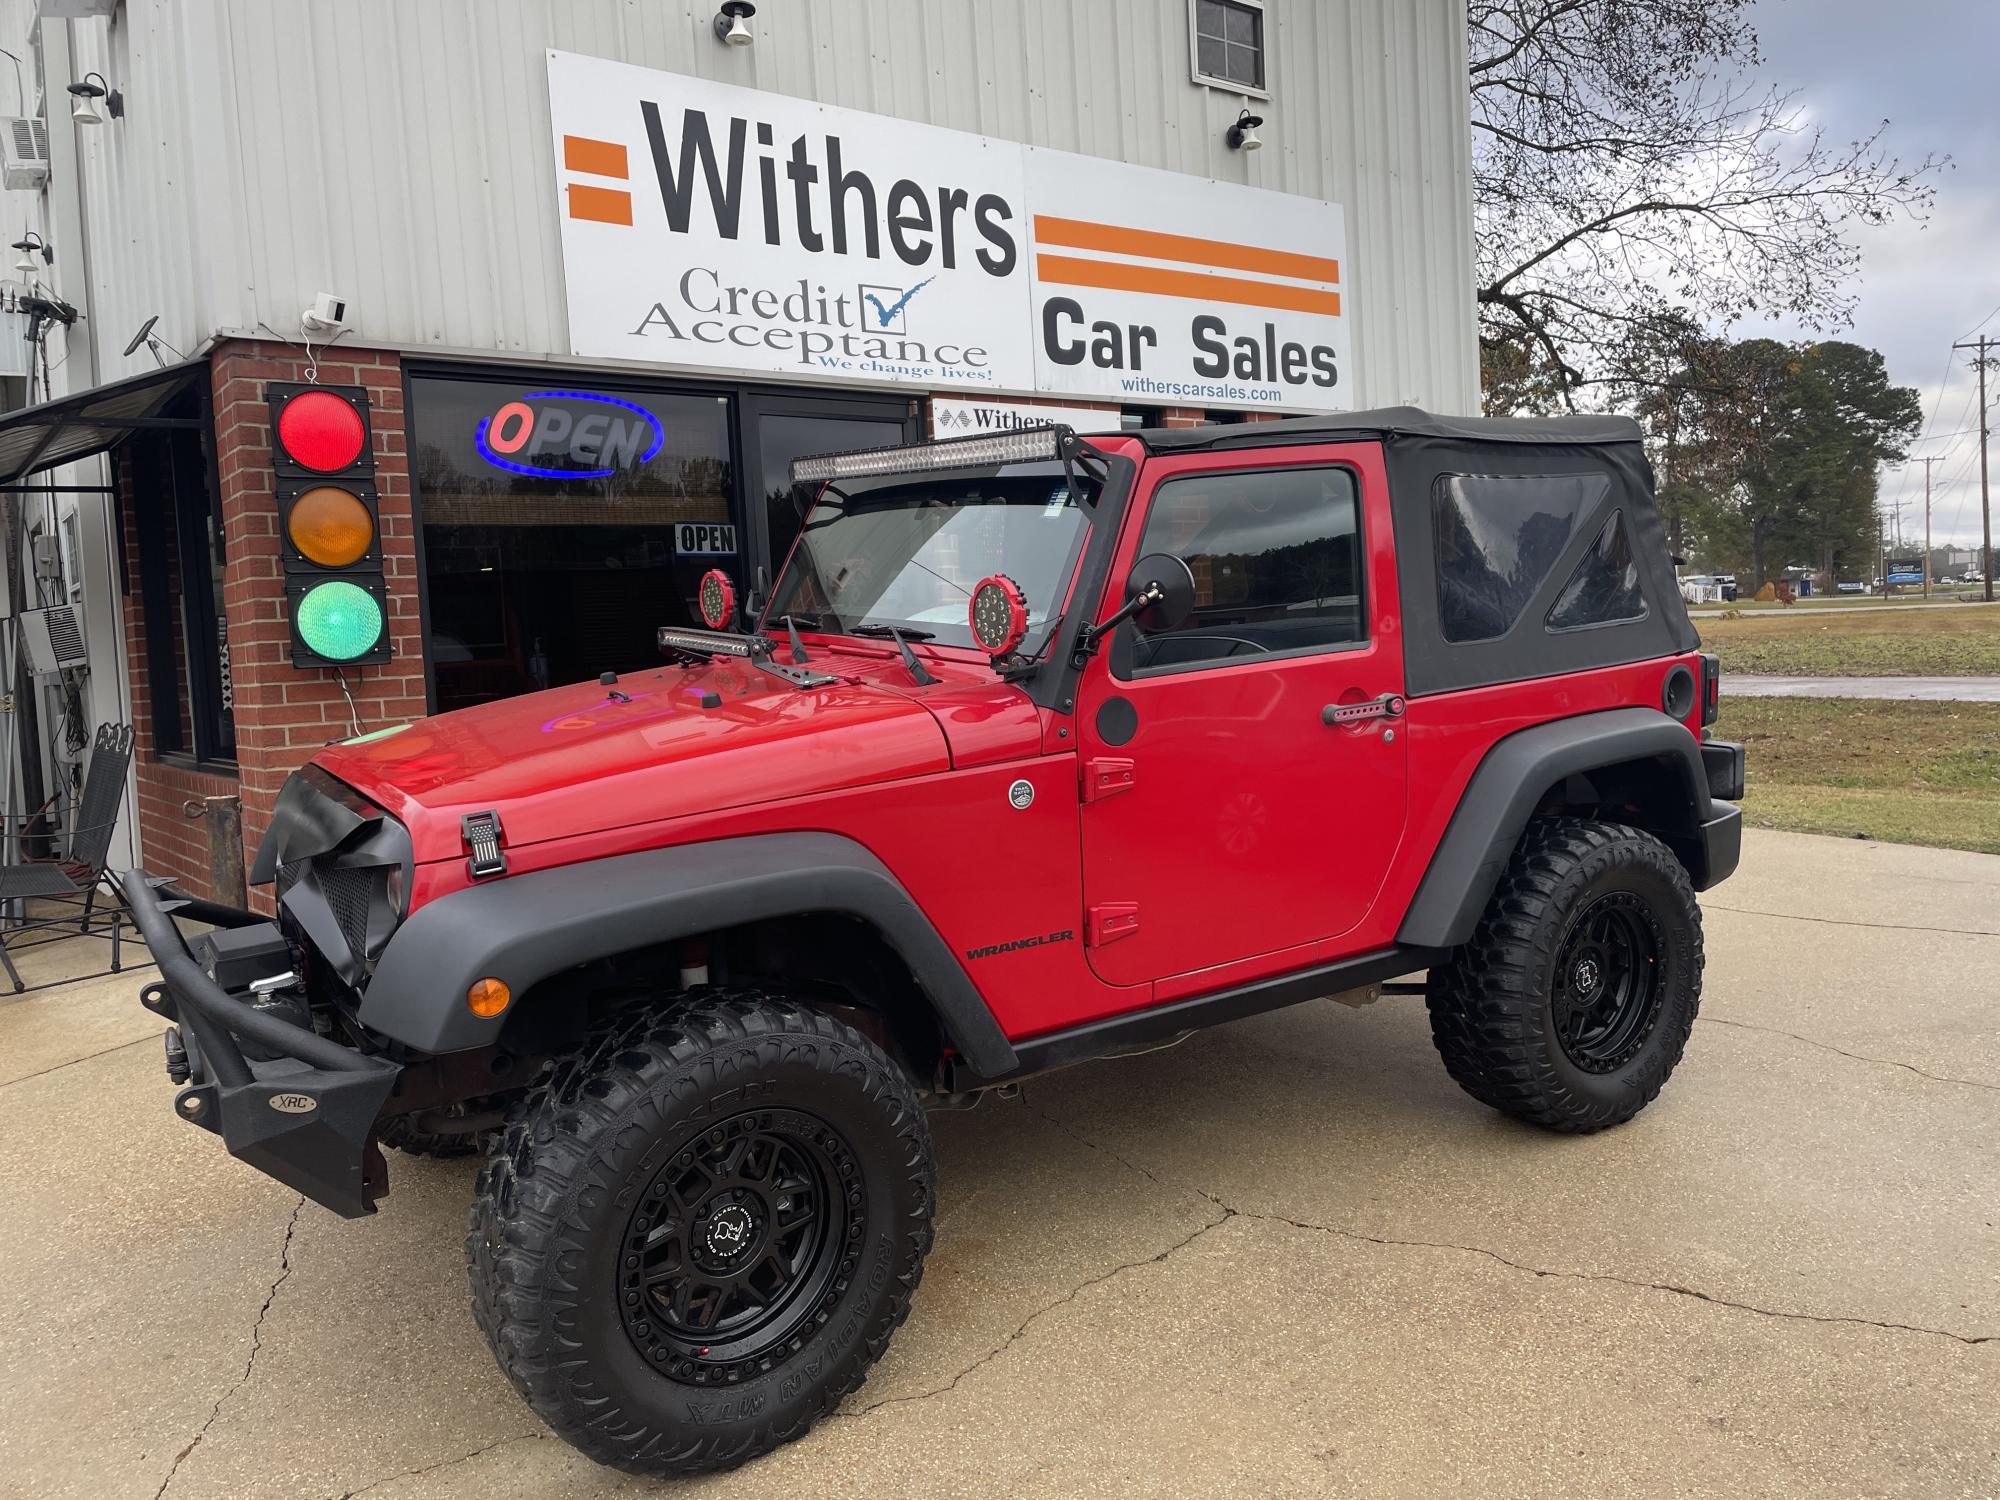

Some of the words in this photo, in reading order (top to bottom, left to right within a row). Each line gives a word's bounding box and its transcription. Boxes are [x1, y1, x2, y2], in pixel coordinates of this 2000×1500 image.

[639, 99, 1017, 278] Withers
[679, 267, 855, 328] Credit
[627, 301, 989, 366] Acceptance
[1042, 296, 1158, 371] Car
[1191, 314, 1338, 388] Sales
[818, 355, 852, 369] We
[859, 360, 934, 379] change
[941, 366, 992, 381] lives!
[1121, 376, 1282, 402] witherscarsales.com
[972, 408, 1055, 430] Withers
[489, 401, 646, 469] OPEN
[680, 525, 735, 553] OPEN
[966, 930, 1073, 960] WRANGLER
[278, 1095, 308, 1109] XRC
[713, 1205, 738, 1221] BLACK
[740, 1207, 753, 1229] RHINO
[718, 1241, 747, 1257] ALLOYS
